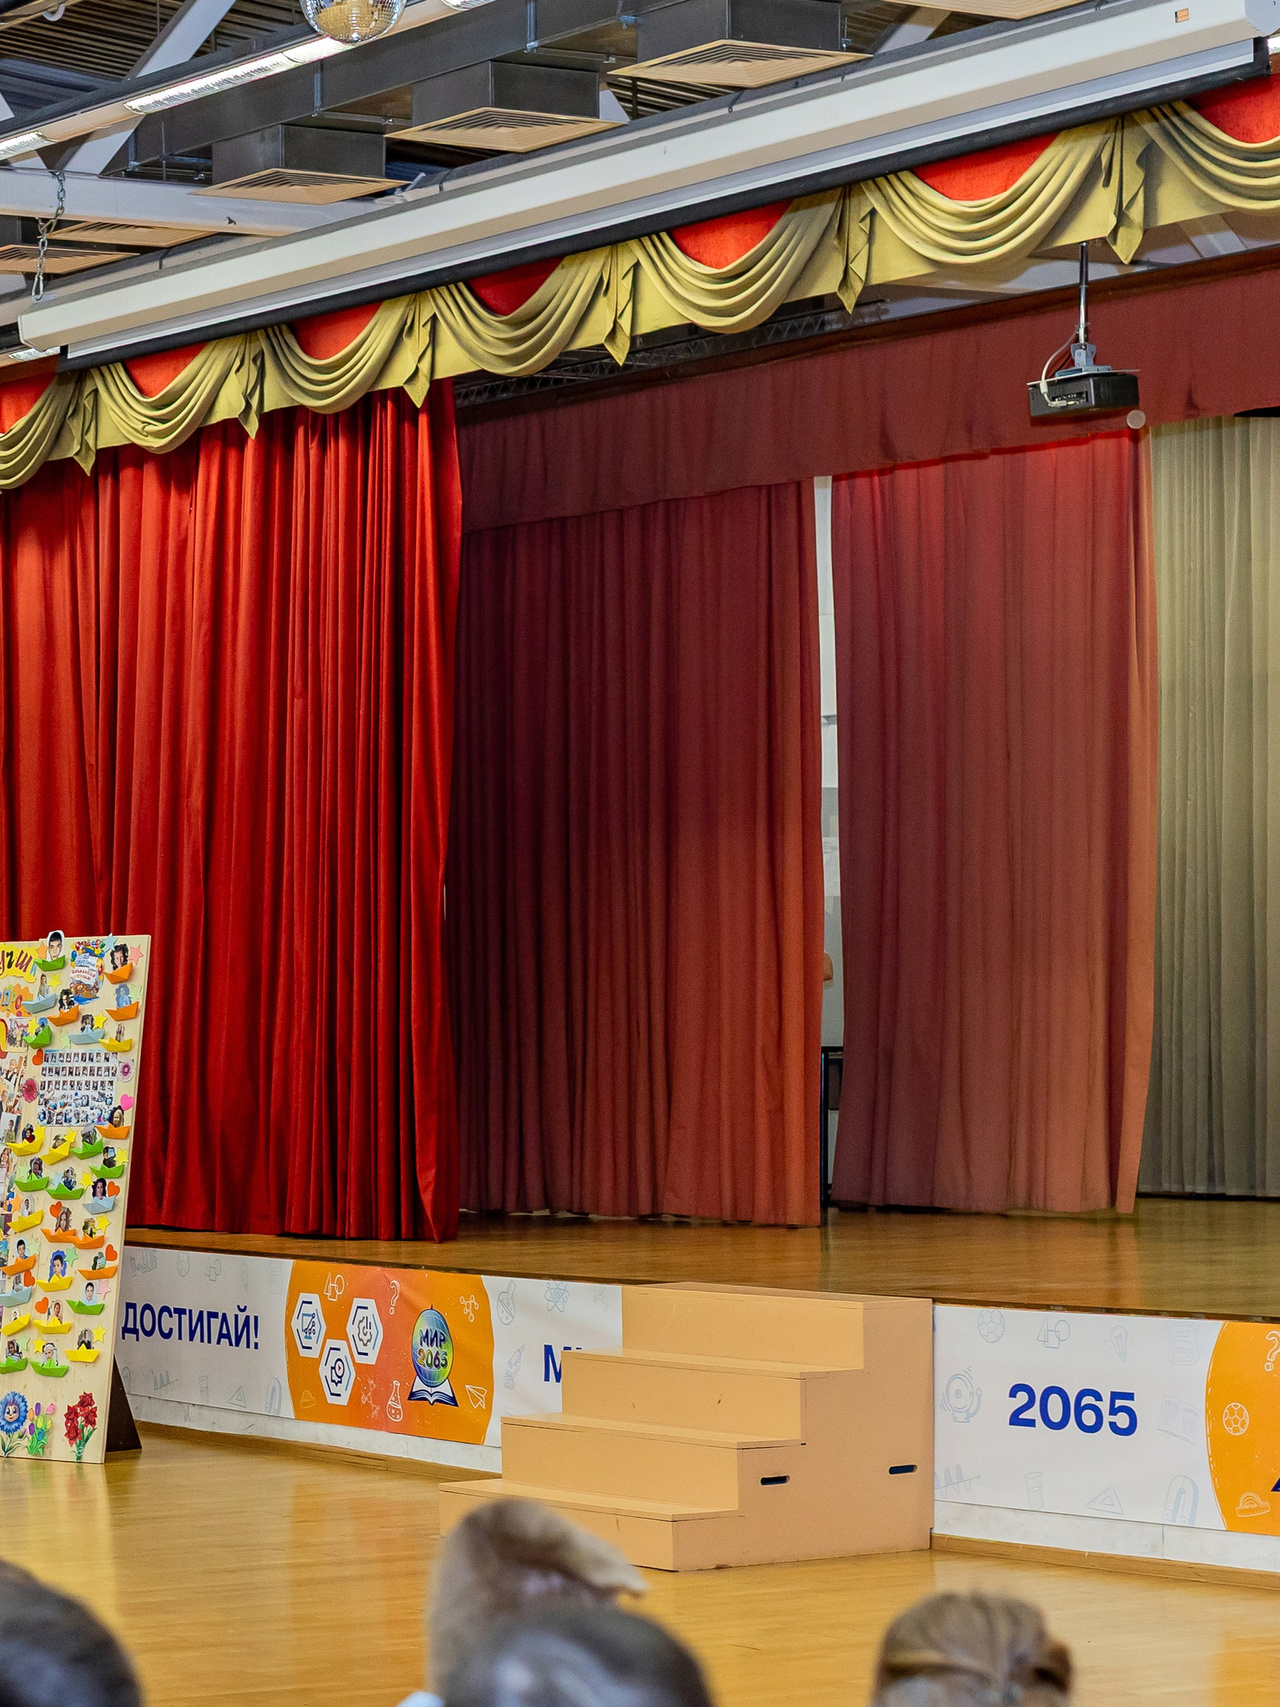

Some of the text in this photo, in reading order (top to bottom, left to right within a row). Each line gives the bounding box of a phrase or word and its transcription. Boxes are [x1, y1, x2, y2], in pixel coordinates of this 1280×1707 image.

[121, 1302, 259, 1350] ДОСТИГАЙ!
[419, 1328, 446, 1350] МИР
[417, 1350, 449, 1371] 2065
[1008, 1383, 1138, 1436] 2065
